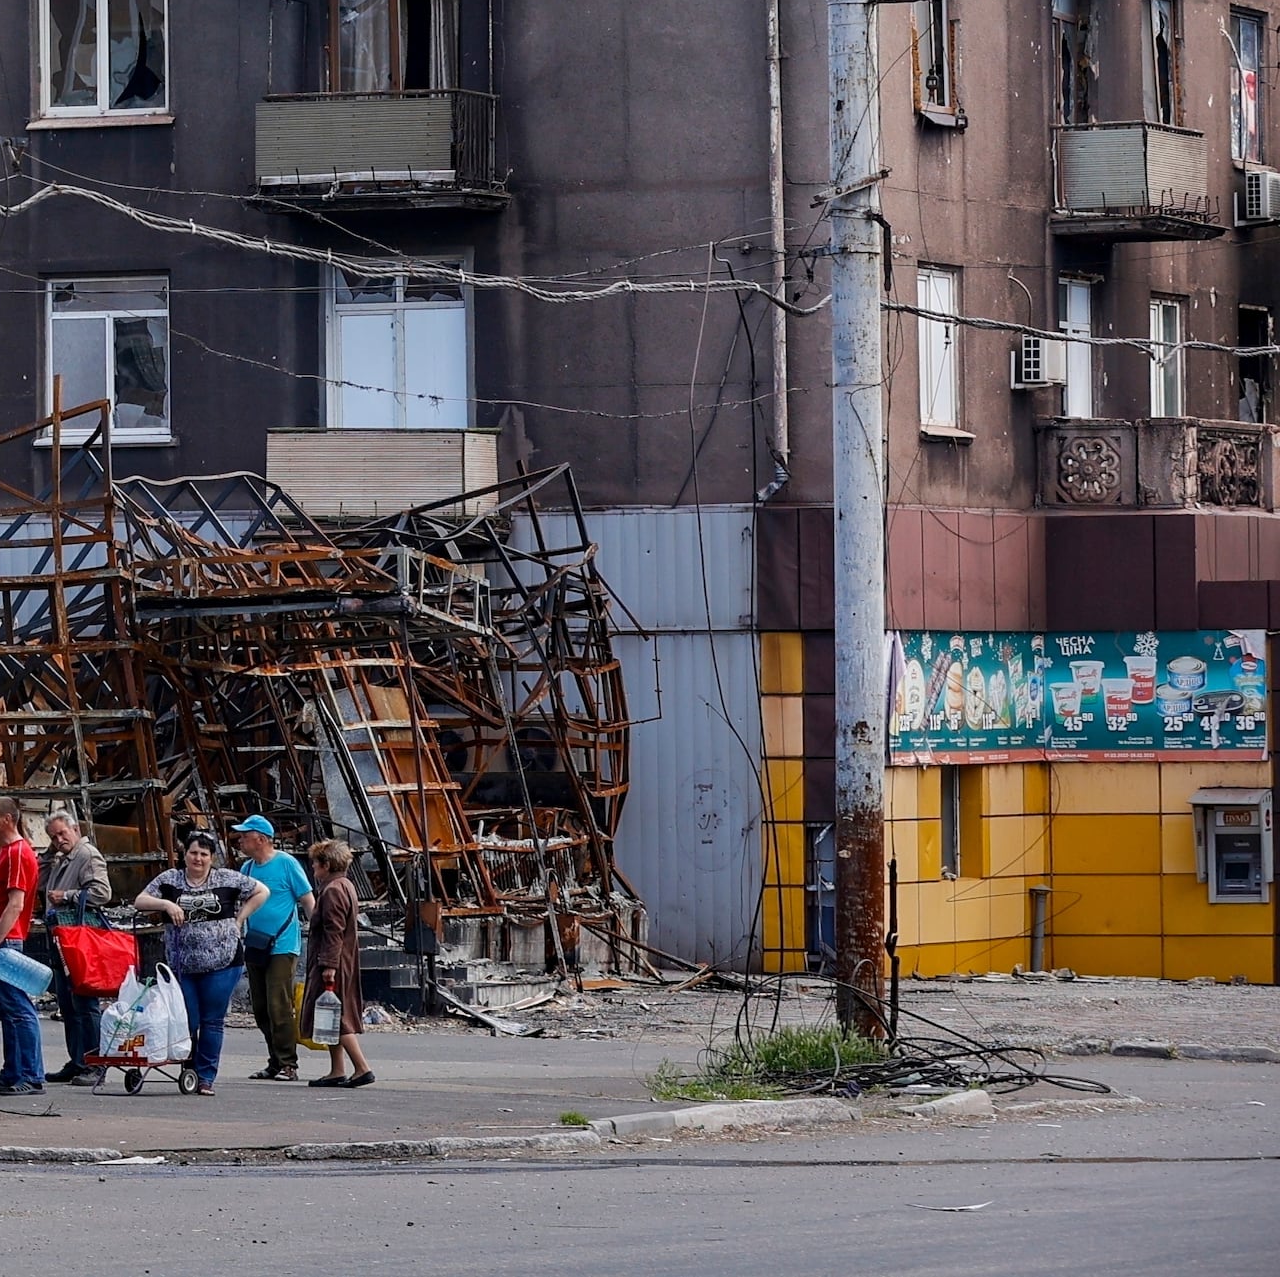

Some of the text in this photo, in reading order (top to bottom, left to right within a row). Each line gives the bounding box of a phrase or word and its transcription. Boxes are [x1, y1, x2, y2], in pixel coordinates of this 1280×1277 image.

[1055, 635, 1096, 649] ЧЕСНА
[1060, 644, 1093, 657] ЦІНА
[1063, 716, 1083, 732] 45
[1107, 716, 1128, 732] 32
[1163, 716, 1183, 732] 25
[1235, 715, 1255, 731] 36
